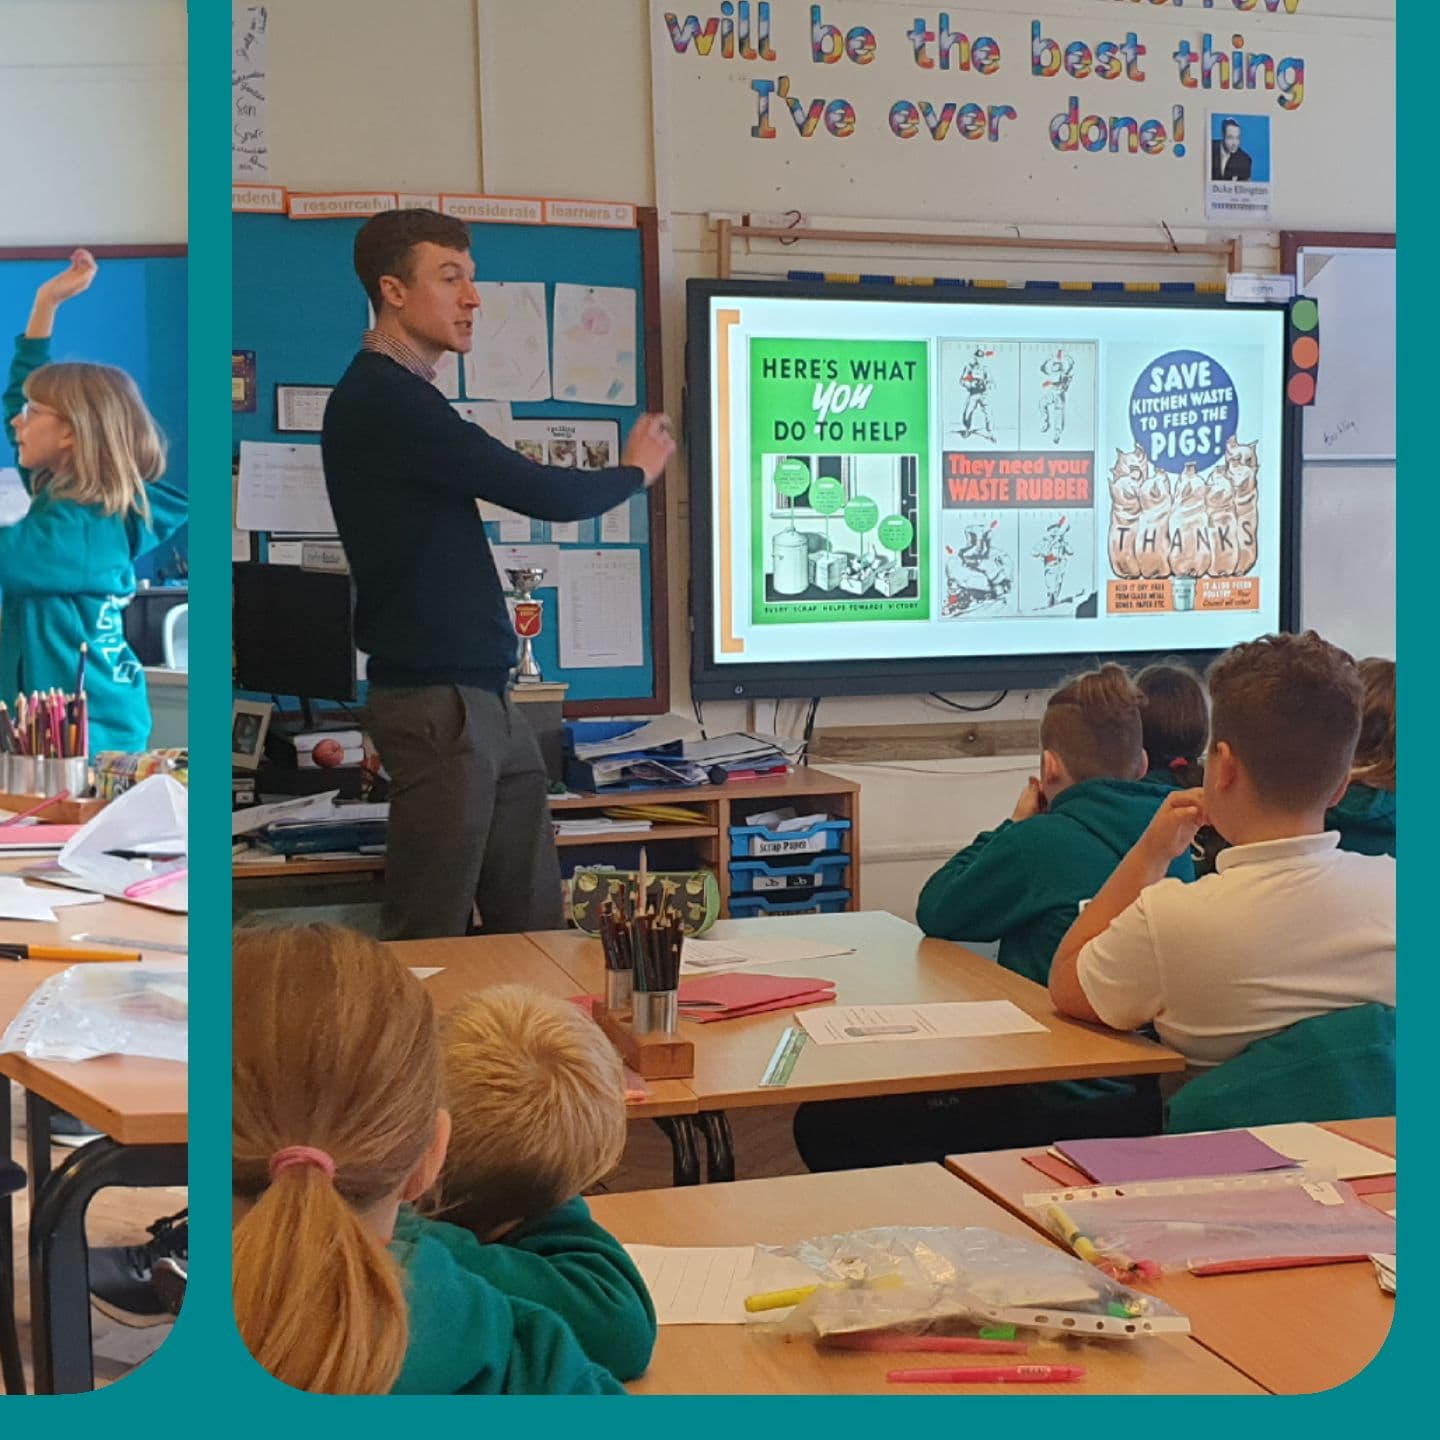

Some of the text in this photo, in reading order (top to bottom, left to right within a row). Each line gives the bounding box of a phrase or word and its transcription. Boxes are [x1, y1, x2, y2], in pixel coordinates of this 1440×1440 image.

[664, 0, 1304, 111] will be the best thing
[751, 75, 1185, 158] I've ever done!
[449, 204, 536, 219] considerate
[551, 205, 610, 220] learners
[763, 358, 917, 381] HERE'S WHAT
[1149, 361, 1212, 393] SAVE
[1132, 387, 1233, 416] KITCHEN WASTE
[1140, 406, 1228, 431] TO FEED THE
[774, 420, 907, 442] DO TO HELP
[1151, 425, 1222, 461] PIGS!
[948, 453, 1090, 477] They need your
[948, 477, 1088, 501] WASTE RUBBER
[760, 841, 806, 852] Scrap Paper
